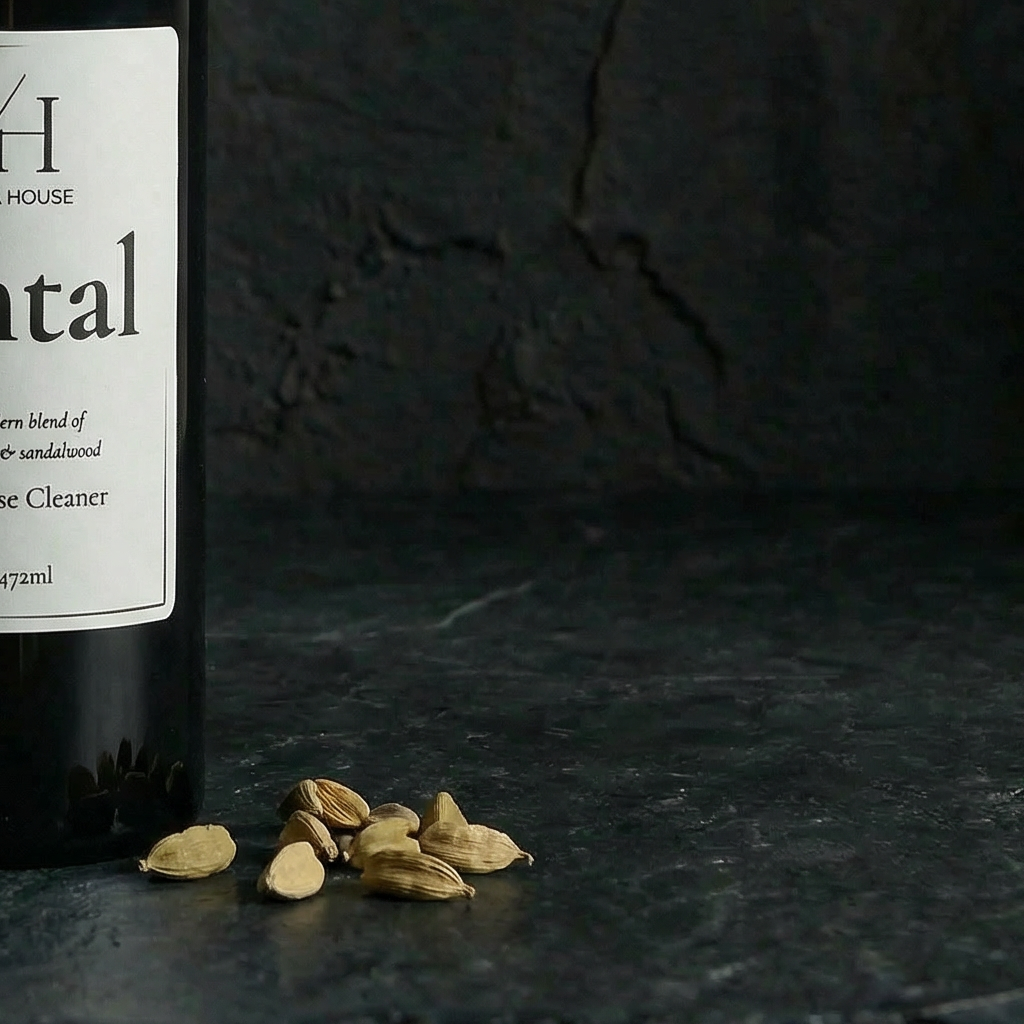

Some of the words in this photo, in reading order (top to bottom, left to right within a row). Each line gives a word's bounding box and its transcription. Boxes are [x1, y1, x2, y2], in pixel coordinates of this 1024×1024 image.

[8, 189, 74, 205] HOUSE
[28, 411, 68, 429] blend
[71, 411, 88, 432] of
[0, 444, 17, 460] &
[19, 439, 102, 460] sandalwood
[26, 485, 109, 509] Cleaner
